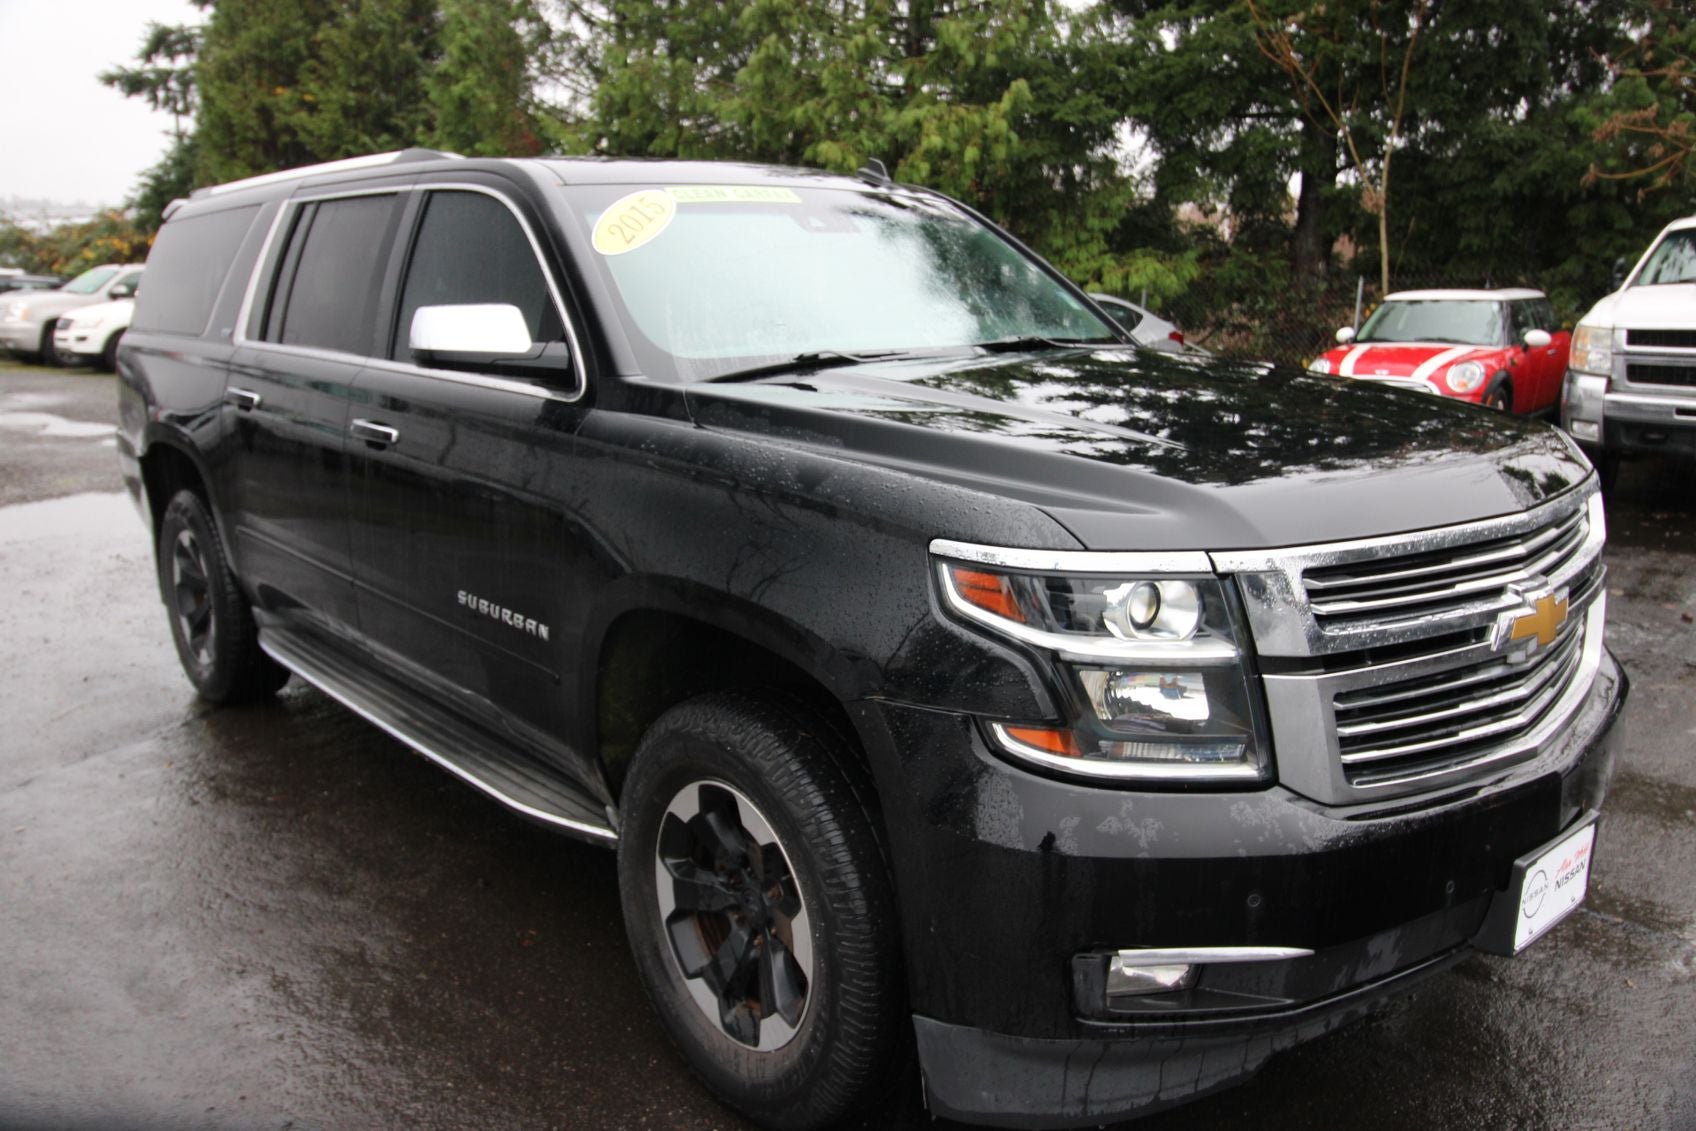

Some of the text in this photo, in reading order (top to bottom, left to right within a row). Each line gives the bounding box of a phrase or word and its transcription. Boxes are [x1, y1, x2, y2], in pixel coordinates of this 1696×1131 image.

[607, 196, 666, 245] 2015
[457, 589, 550, 642] SUBURBAN
[1522, 882, 1549, 905] NISSAN
[1554, 859, 1587, 892] NISSAN
